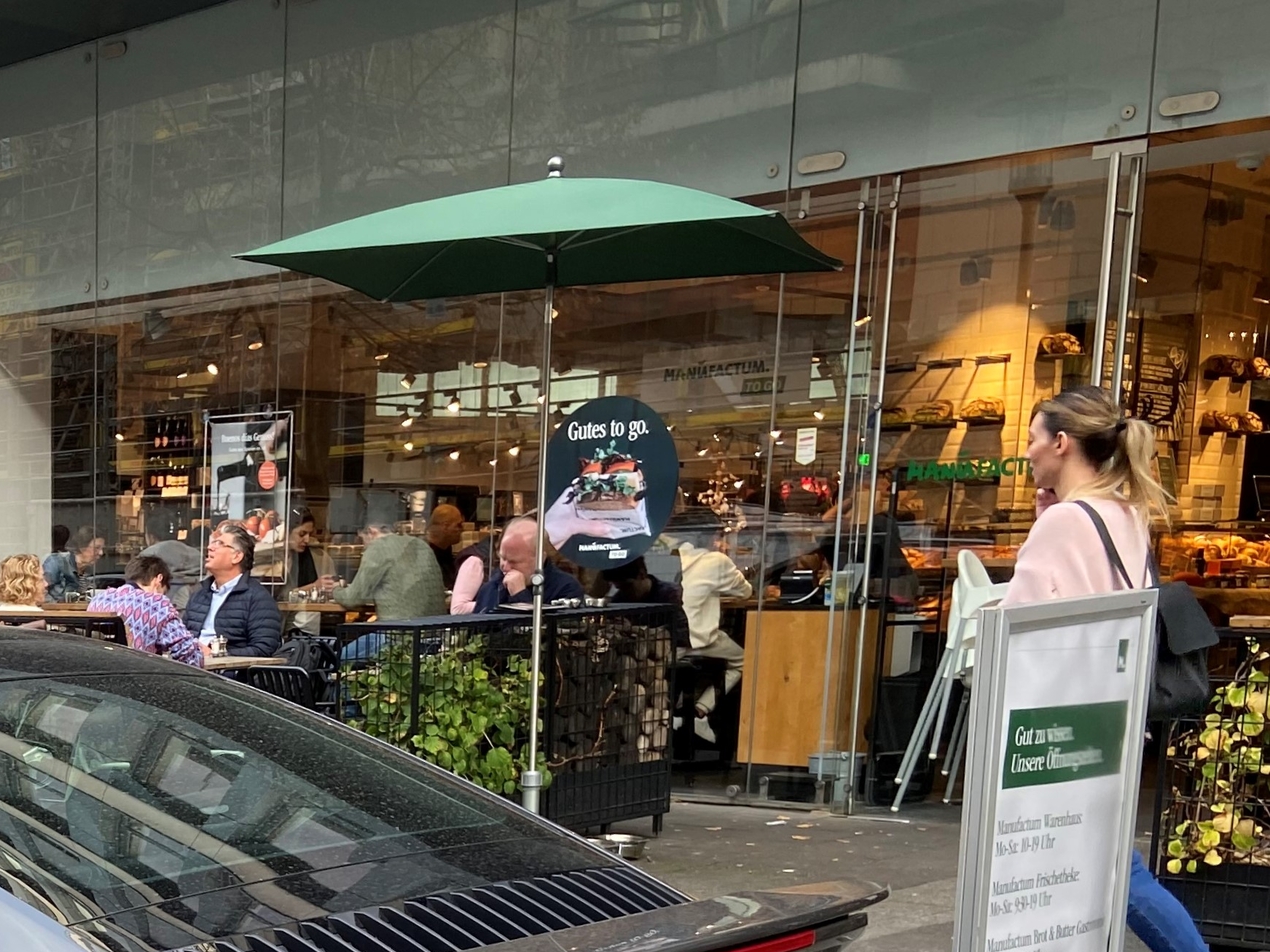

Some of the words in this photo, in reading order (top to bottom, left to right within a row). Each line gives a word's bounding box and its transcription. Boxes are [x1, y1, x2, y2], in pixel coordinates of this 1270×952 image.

[567, 421, 606, 441] Gutes
[610, 420, 625, 437] to
[628, 419, 650, 441] go.
[906, 451, 1030, 482] MANUFACT
[1015, 726, 1034, 746] Gut
[1035, 729, 1046, 744] zu
[1011, 753, 1045, 773] Unsere
[997, 816, 1041, 836] Manufactum
[1041, 833, 1056, 850] Uhr
[992, 876, 1034, 897] Manufactum
[1039, 891, 1052, 908] Uhr
[1033, 929, 1048, 945] Brot
[1048, 926, 1055, 941] &
